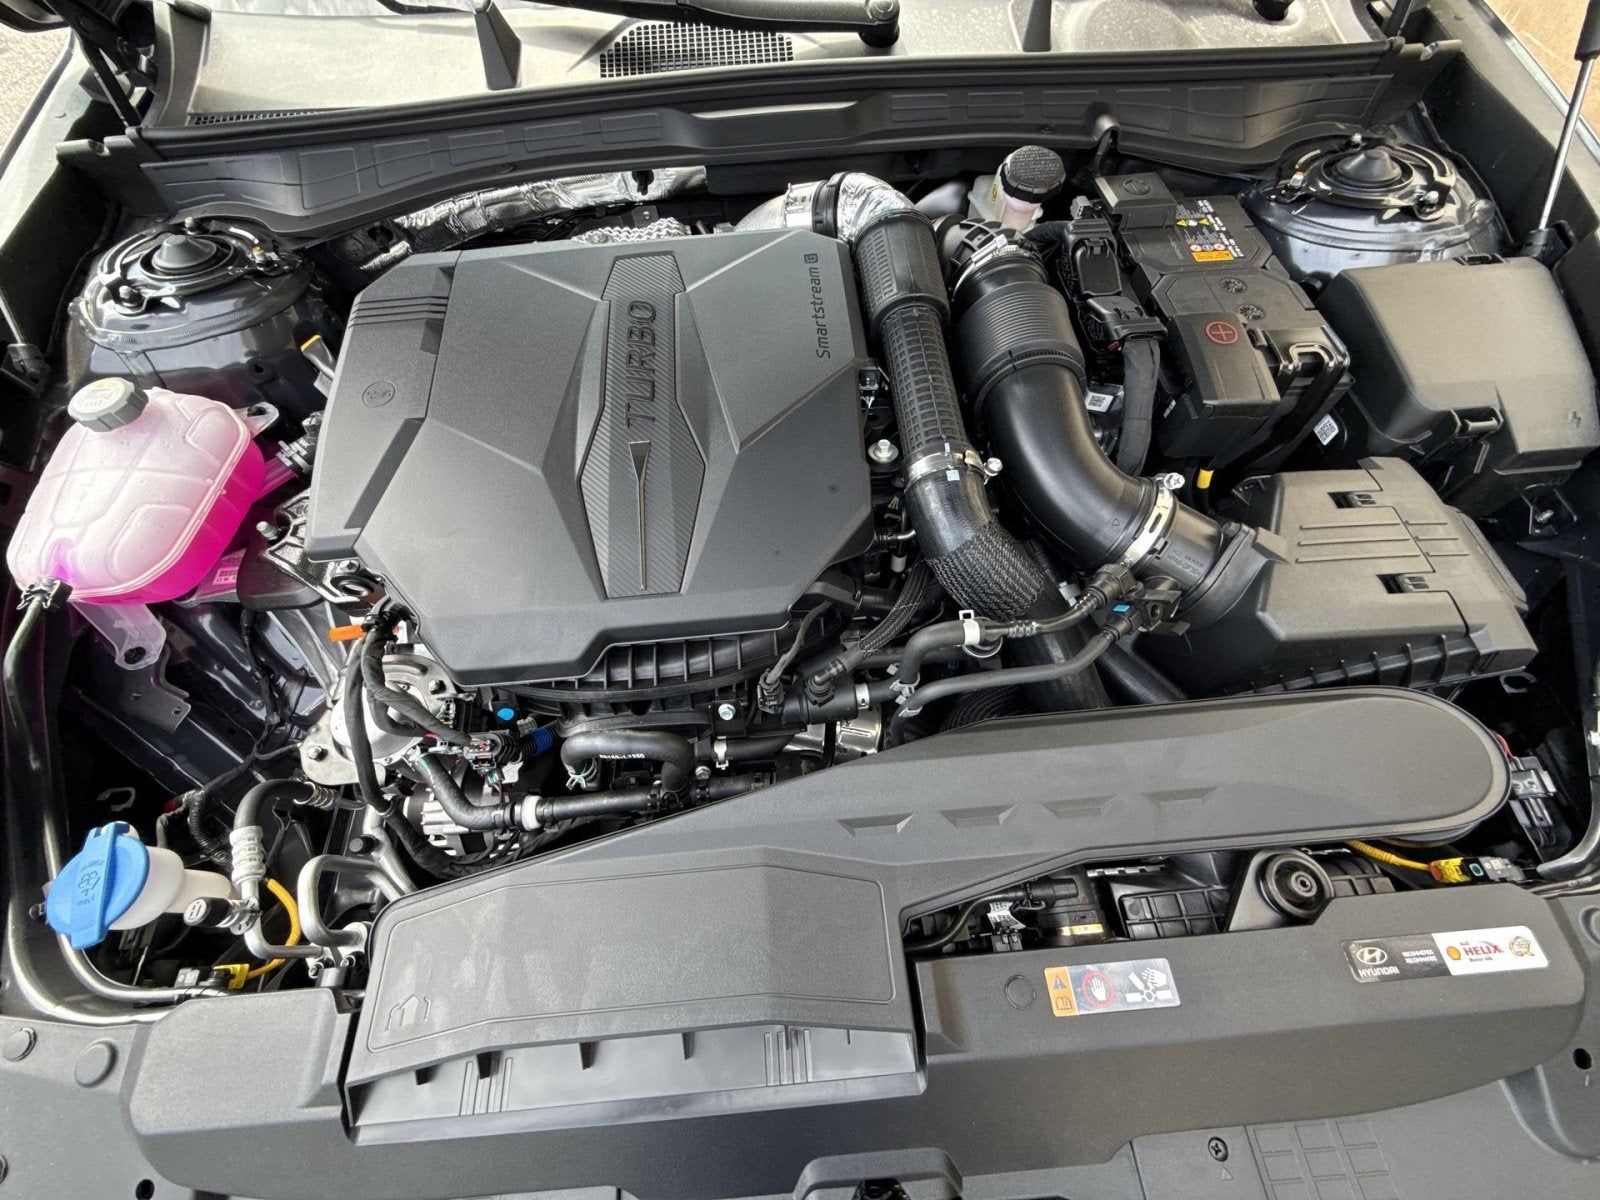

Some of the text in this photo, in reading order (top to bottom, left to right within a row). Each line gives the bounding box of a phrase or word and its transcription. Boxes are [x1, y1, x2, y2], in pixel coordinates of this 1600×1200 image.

[808, 267, 831, 360] Smartstream
[625, 300, 656, 429] TURBO
[1358, 965, 1400, 978] HYUNDAI
[1463, 944, 1503, 956] HELIX
